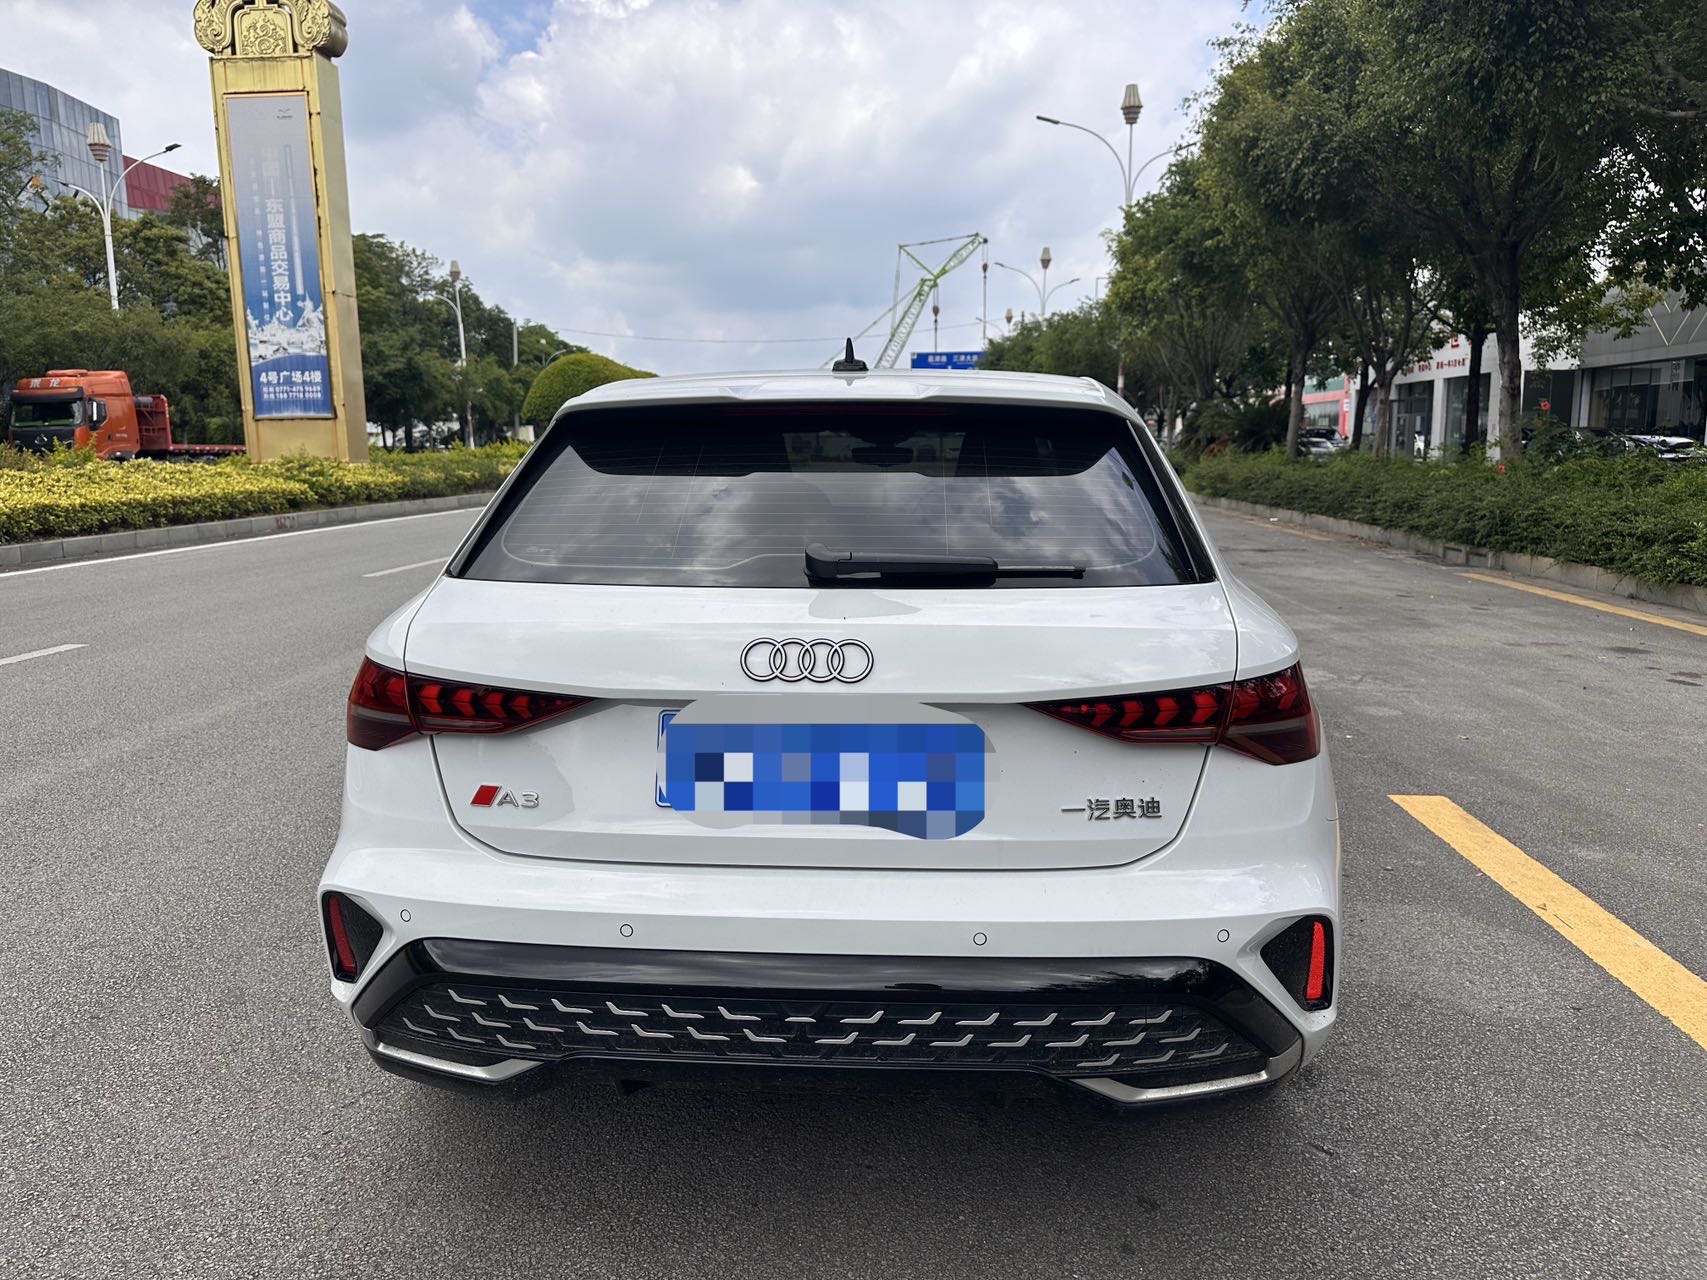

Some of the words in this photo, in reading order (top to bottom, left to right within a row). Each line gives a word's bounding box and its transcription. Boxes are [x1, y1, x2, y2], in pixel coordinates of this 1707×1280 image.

[259, 370, 322, 384] 4号广场4楼
[497, 790, 540, 808] A3
[1061, 797, 1162, 821] 一汽奥迪
